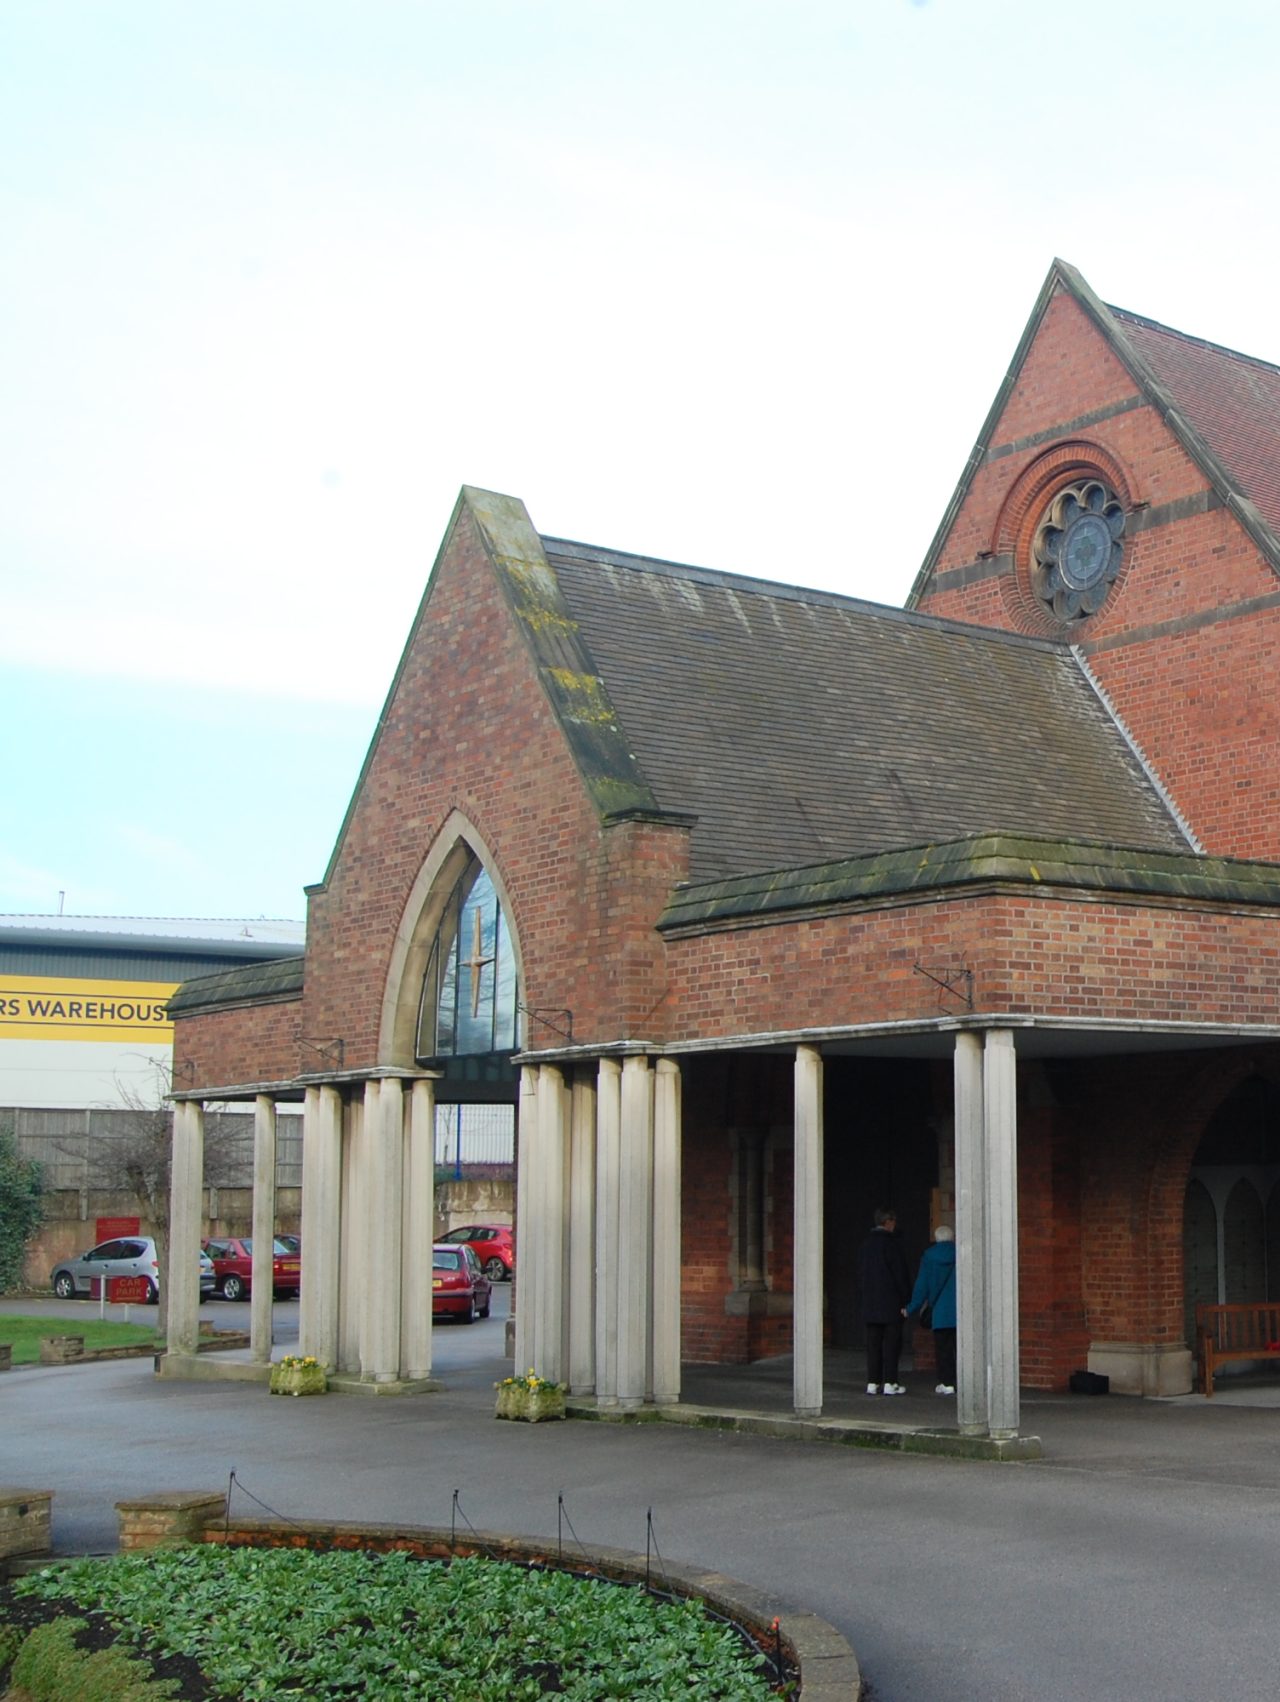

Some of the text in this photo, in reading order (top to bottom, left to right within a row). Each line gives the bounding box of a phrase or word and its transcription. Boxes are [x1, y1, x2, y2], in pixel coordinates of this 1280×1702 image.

[28, 999, 165, 1021] WAREHOUS
[119, 1279, 141, 1287] CAR
[116, 1287, 143, 1296] PARK
